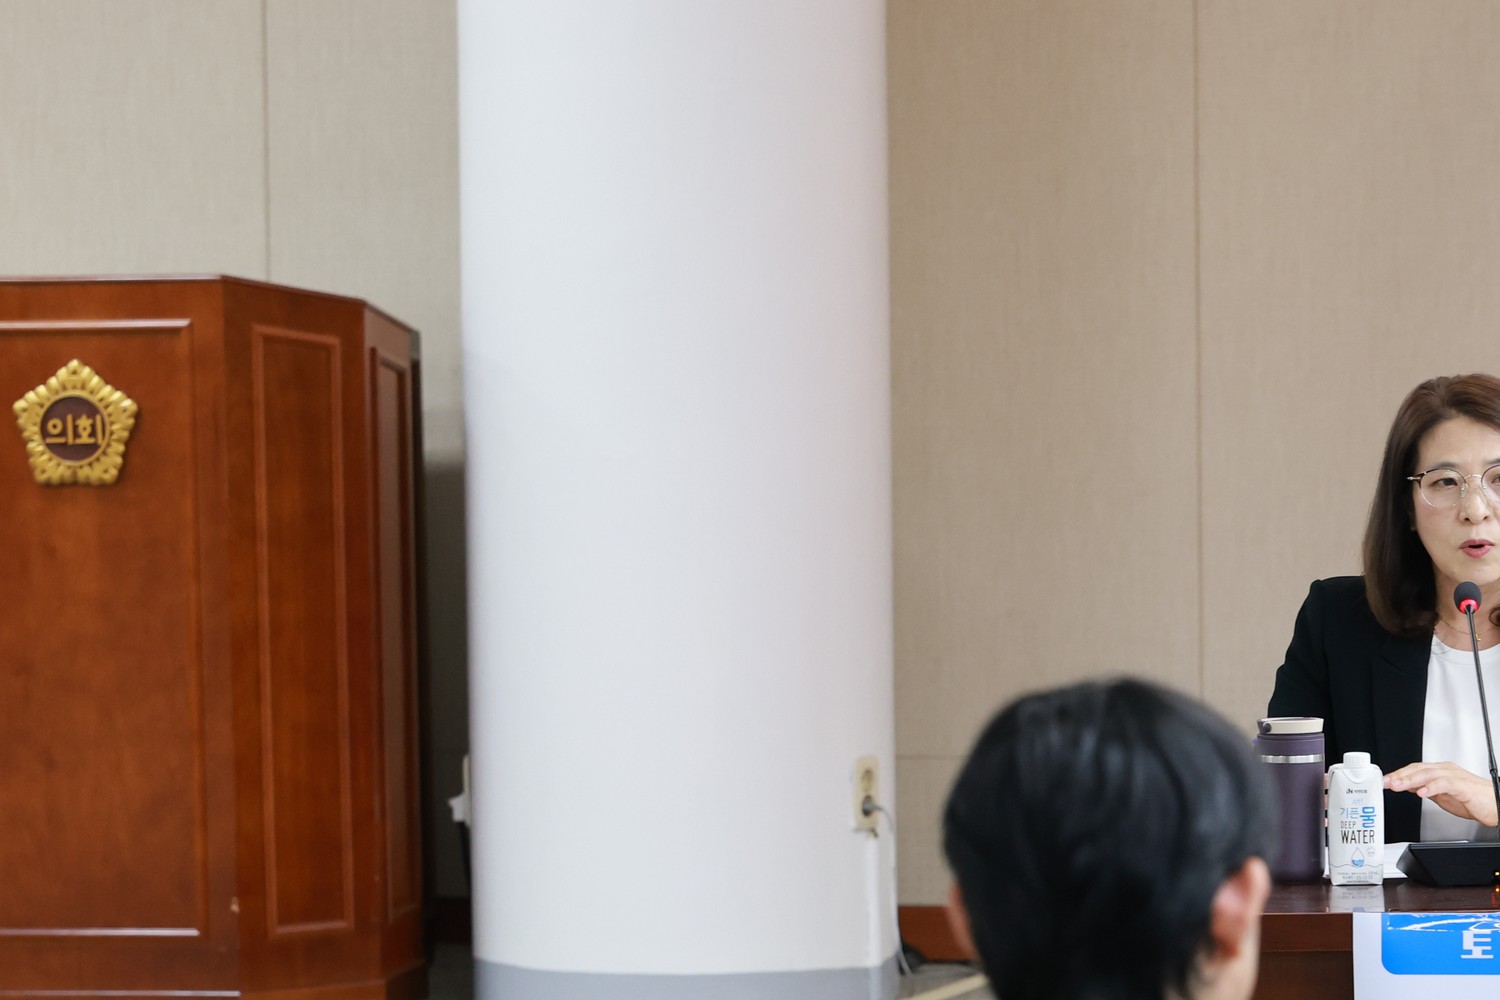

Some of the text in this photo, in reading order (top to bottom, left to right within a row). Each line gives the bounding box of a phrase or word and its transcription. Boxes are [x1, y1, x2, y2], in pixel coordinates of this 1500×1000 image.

[46, 413, 103, 445] 의회
[1340, 820, 1356, 829] DEEP
[1360, 806, 1377, 829] 물
[1340, 829, 1375, 844] WATER
